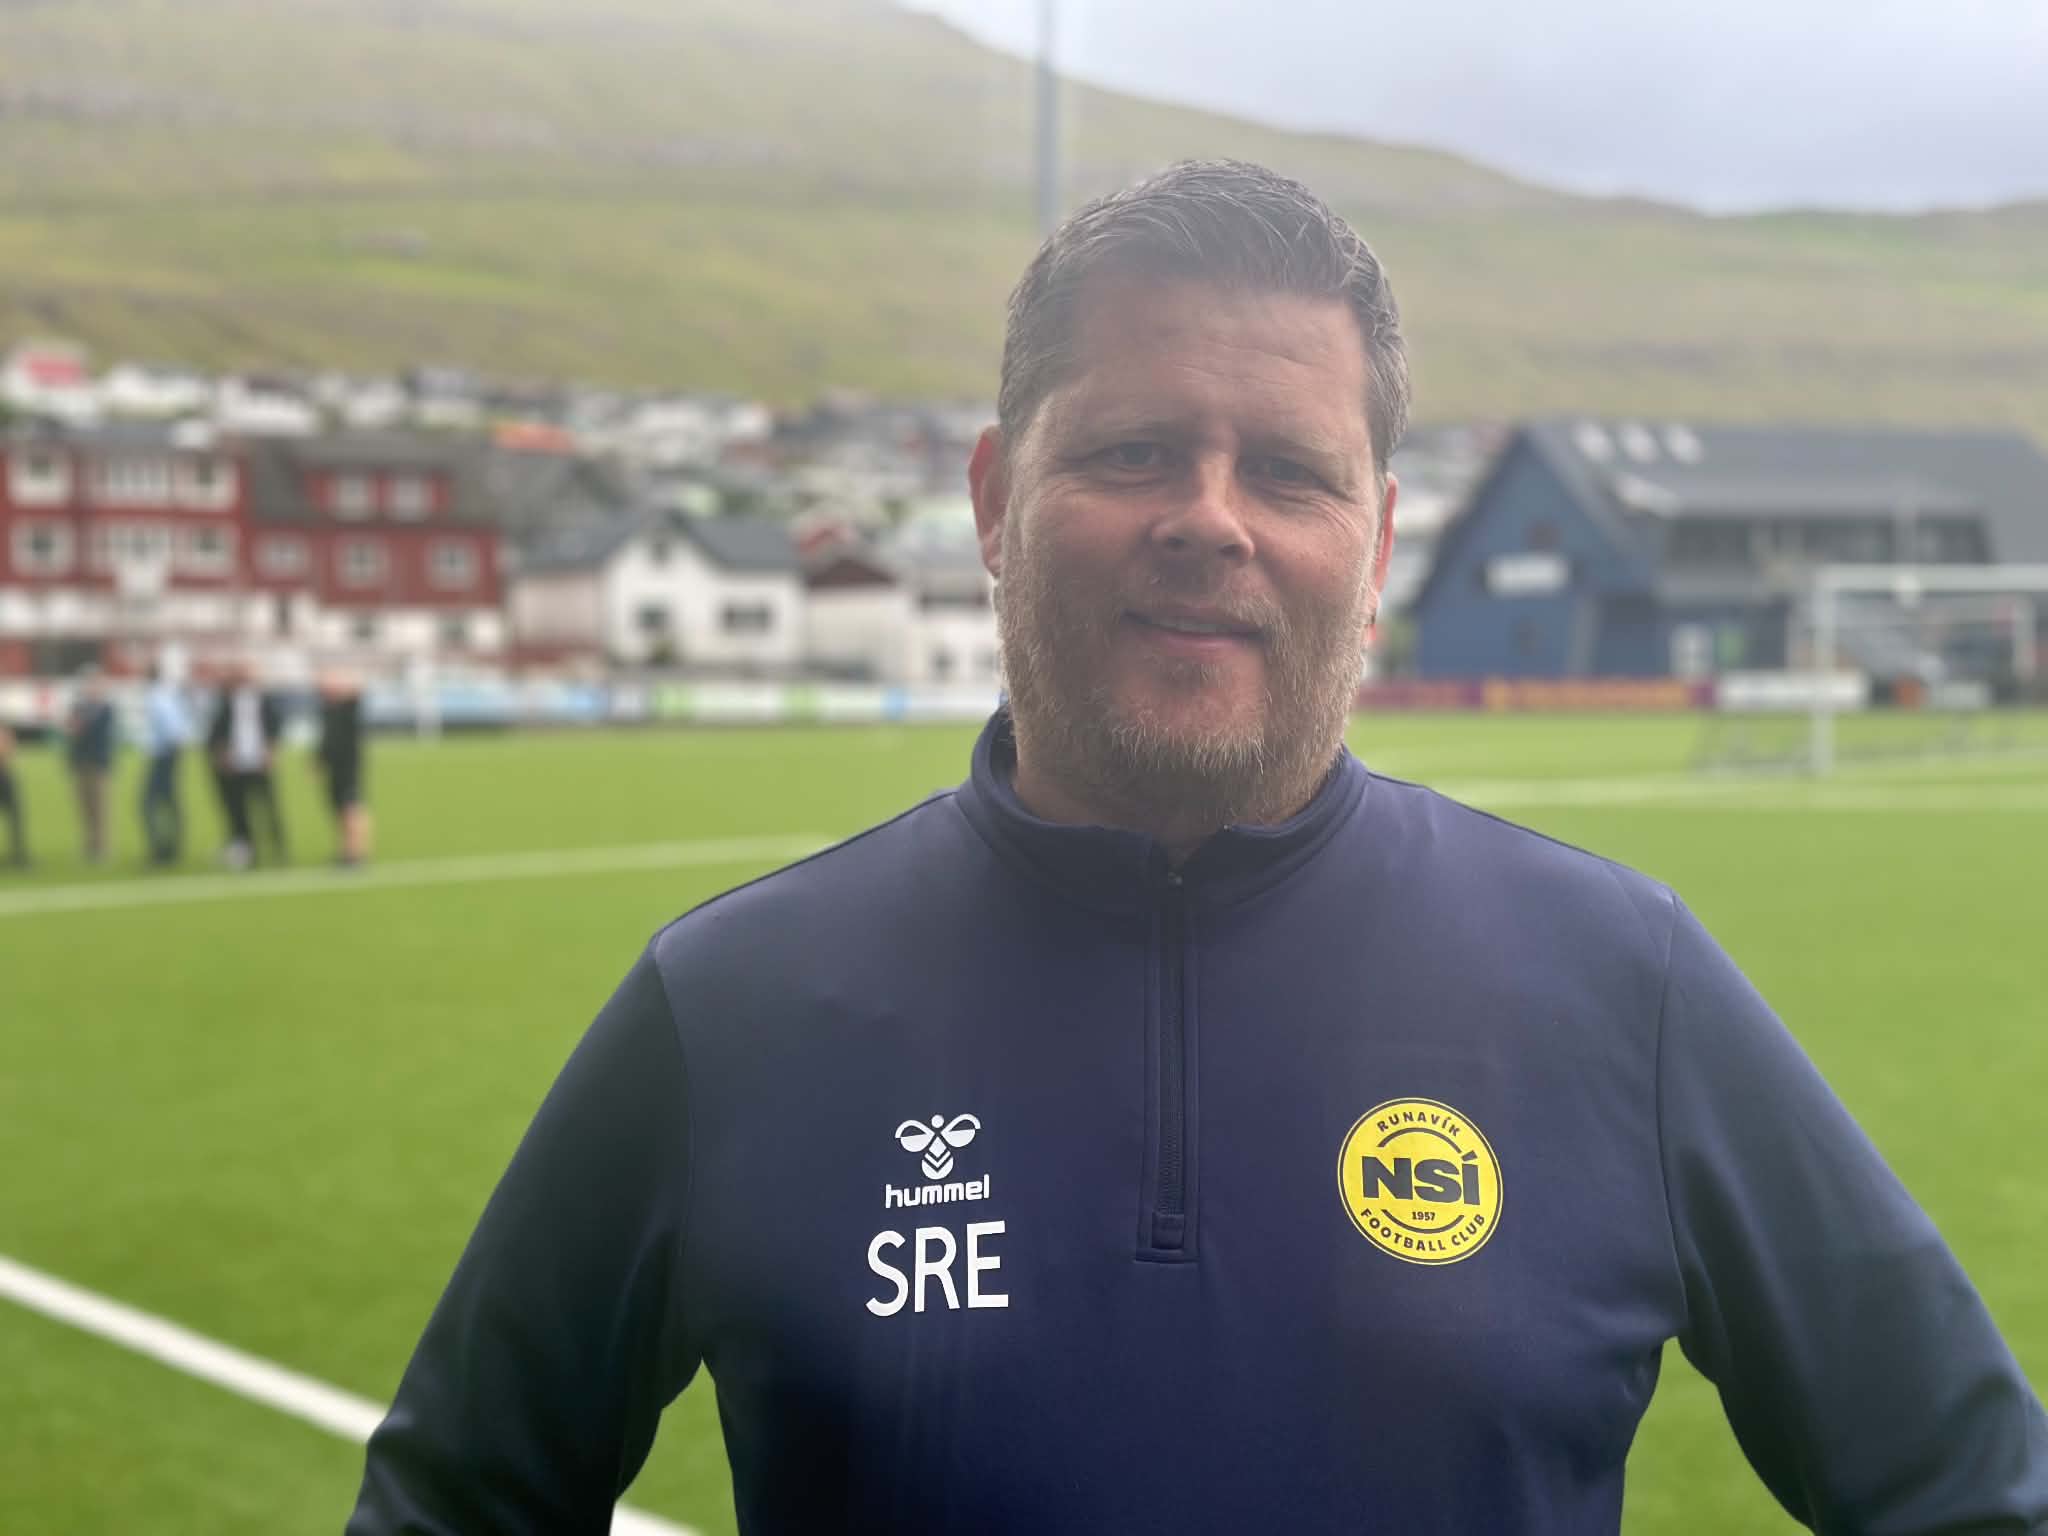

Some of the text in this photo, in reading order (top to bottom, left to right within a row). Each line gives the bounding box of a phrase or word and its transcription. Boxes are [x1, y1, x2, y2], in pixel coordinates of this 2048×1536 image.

[1377, 1111, 1461, 1137] RUNAVÍK
[885, 1174, 990, 1208] hummel
[1361, 1150, 1480, 1206] NSÍ
[1361, 1208, 1485, 1251] FOOTBALL CLUB
[1411, 1211, 1436, 1221] 1957
[865, 1220, 1009, 1317] SRE
